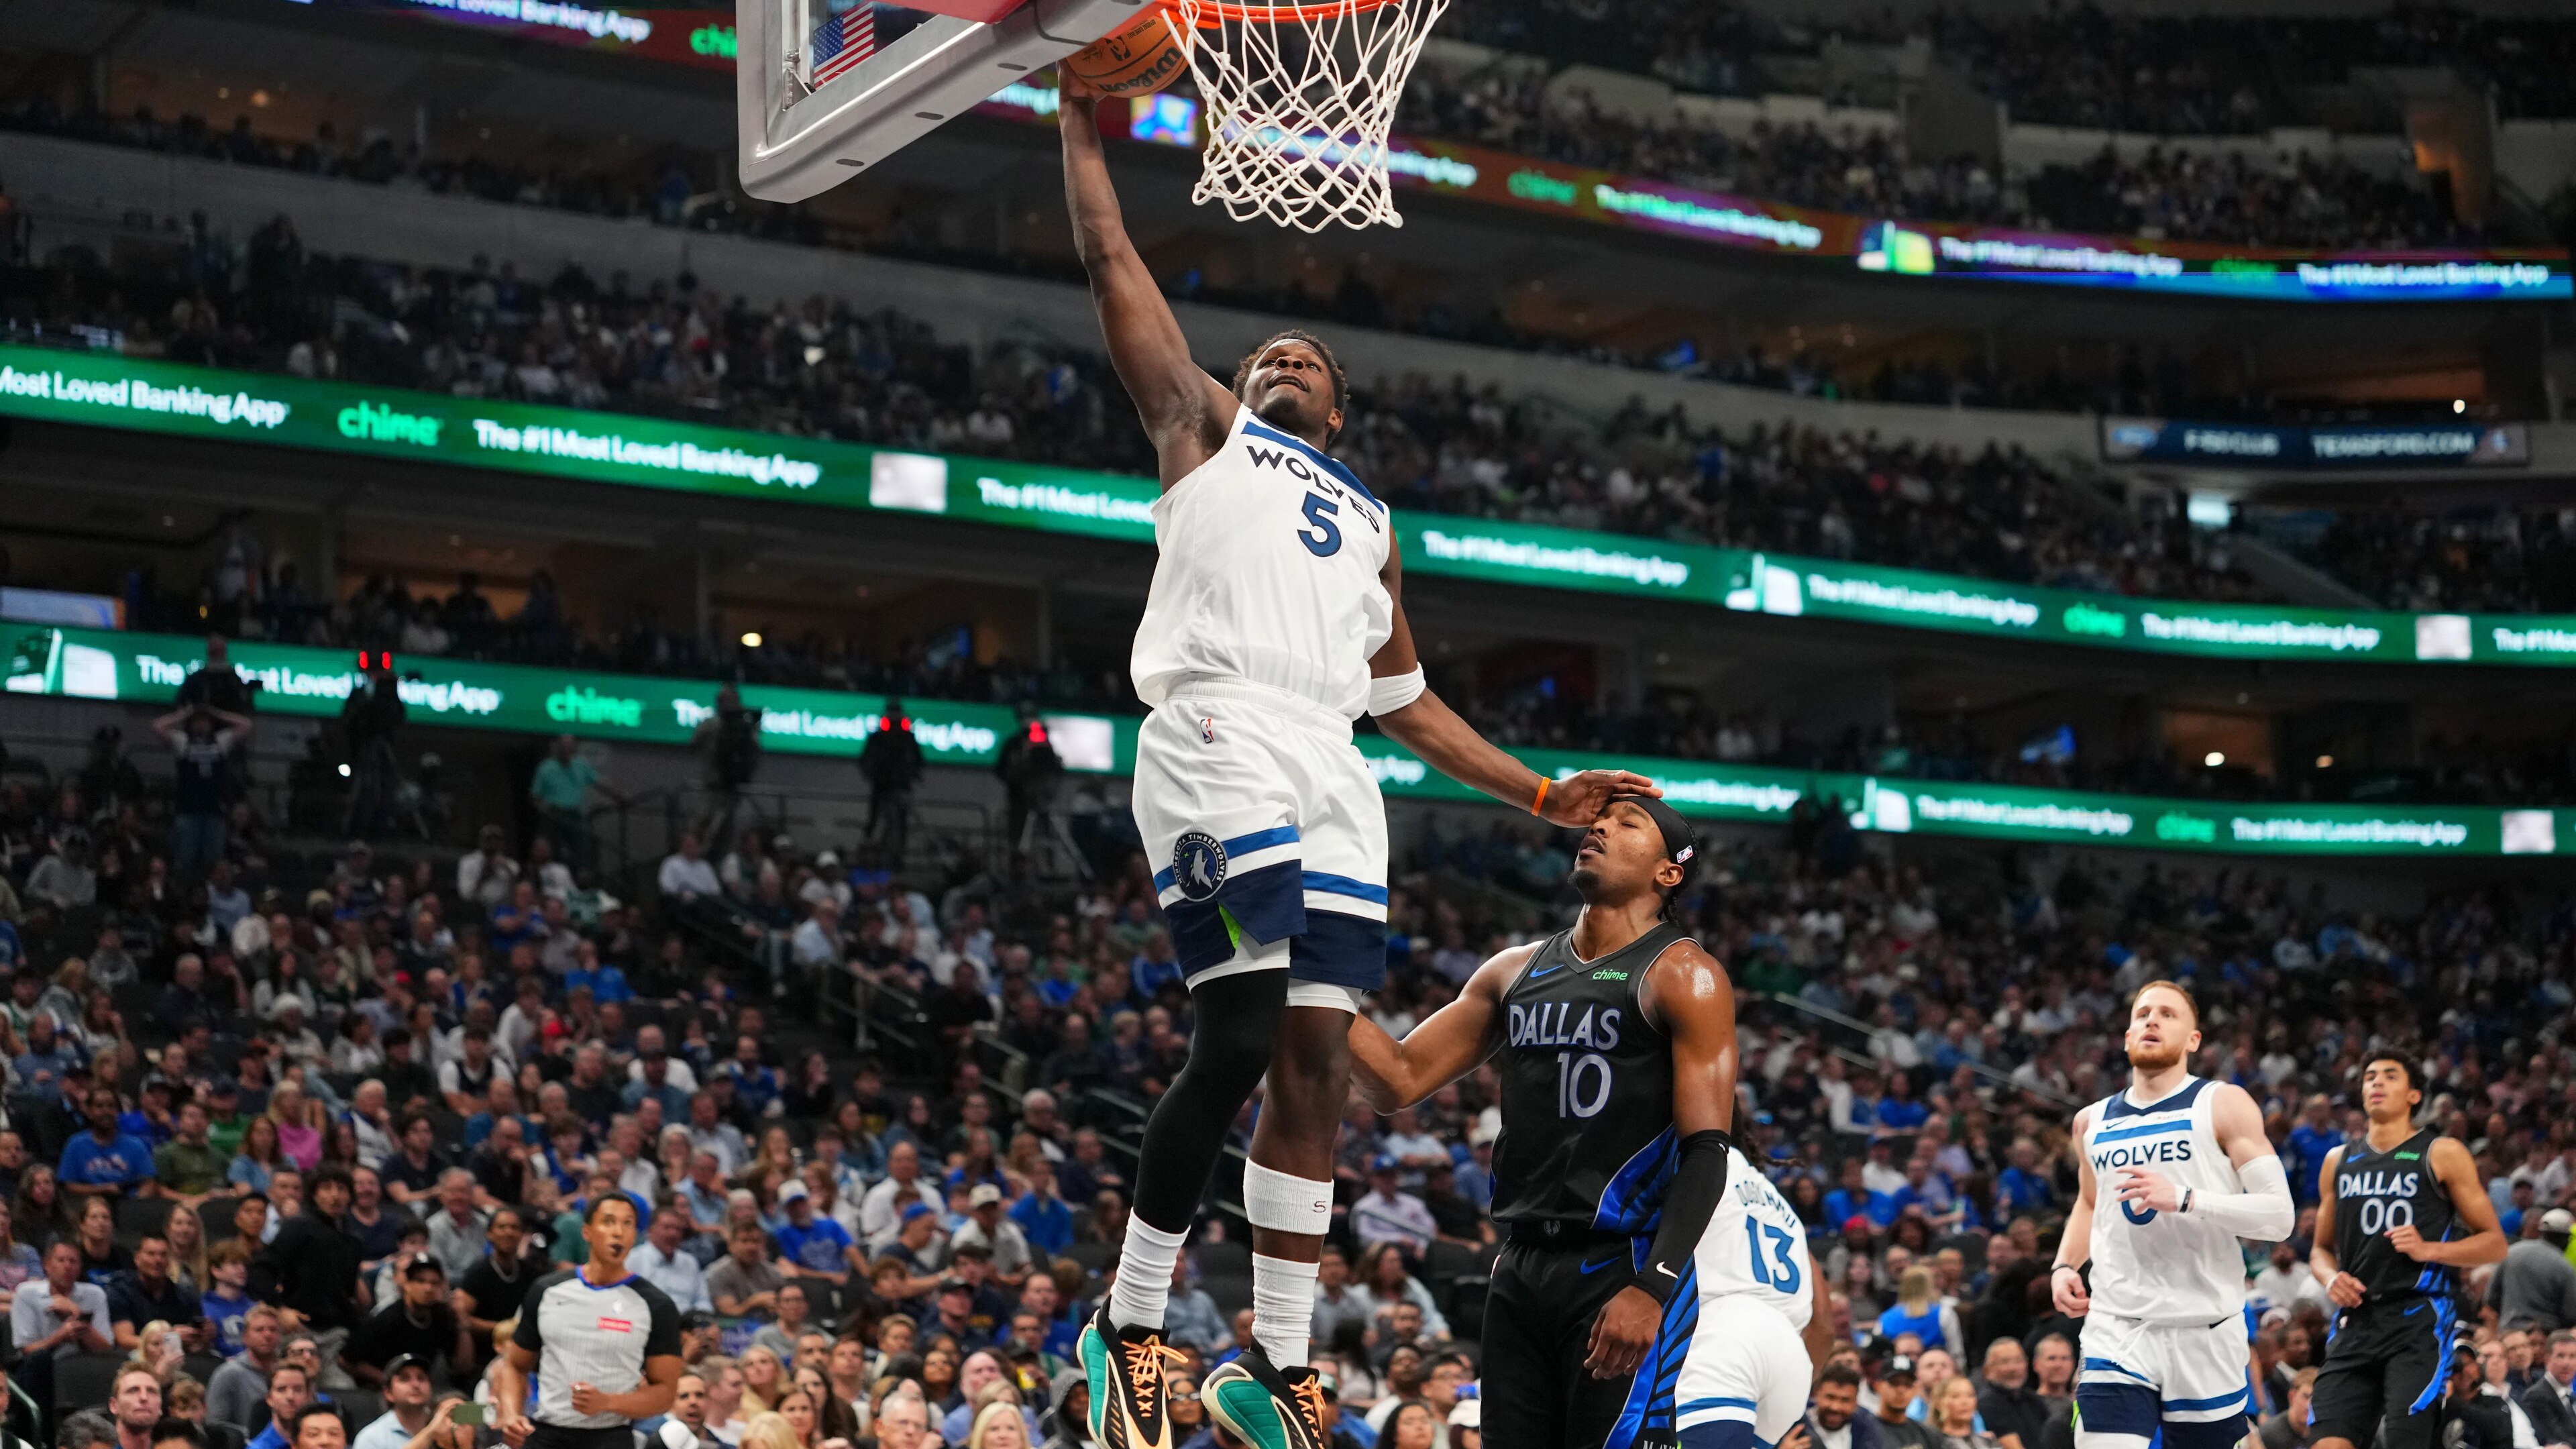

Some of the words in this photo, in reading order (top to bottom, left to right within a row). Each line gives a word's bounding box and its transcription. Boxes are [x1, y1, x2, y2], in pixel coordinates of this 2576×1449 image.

[604, 10, 652, 44] App
[690, 24, 737, 59] chi
[1098, 46, 1182, 93] Wilson
[54, 370, 127, 407] Loved
[131, 380, 231, 423] Banking
[231, 392, 286, 428] App
[337, 400, 440, 447] chime
[473, 419, 520, 450] The
[522, 426, 550, 454] #1
[551, 428, 610, 461] Most
[612, 434, 678, 469] Loved
[680, 443, 769, 484] Banking
[770, 453, 818, 488] App
[977, 478, 1020, 508] The
[1046, 486, 1097, 517] Most
[1297, 490, 1342, 558] 5
[1422, 530, 1459, 559] The
[136, 655, 184, 685] The
[282, 667, 352, 699] Loved
[449, 681, 498, 714] App
[545, 684, 642, 727] chime
[802, 709, 865, 740] Loved
[949, 721, 995, 753] App
[1174, 839, 1186, 884] MINNESOTA
[1188, 835, 1225, 881] TIMBERWOLVES
[1592, 969, 1628, 981] chime
[1508, 1000, 1621, 1051] DALLAS
[1556, 1051, 1613, 1118] 10
[2091, 1140, 2191, 1173] WOLVES
[2339, 1171, 2419, 1199] DALLAS
[2360, 1197, 2414, 1235] 00
[1746, 1214, 1801, 1295] 13
